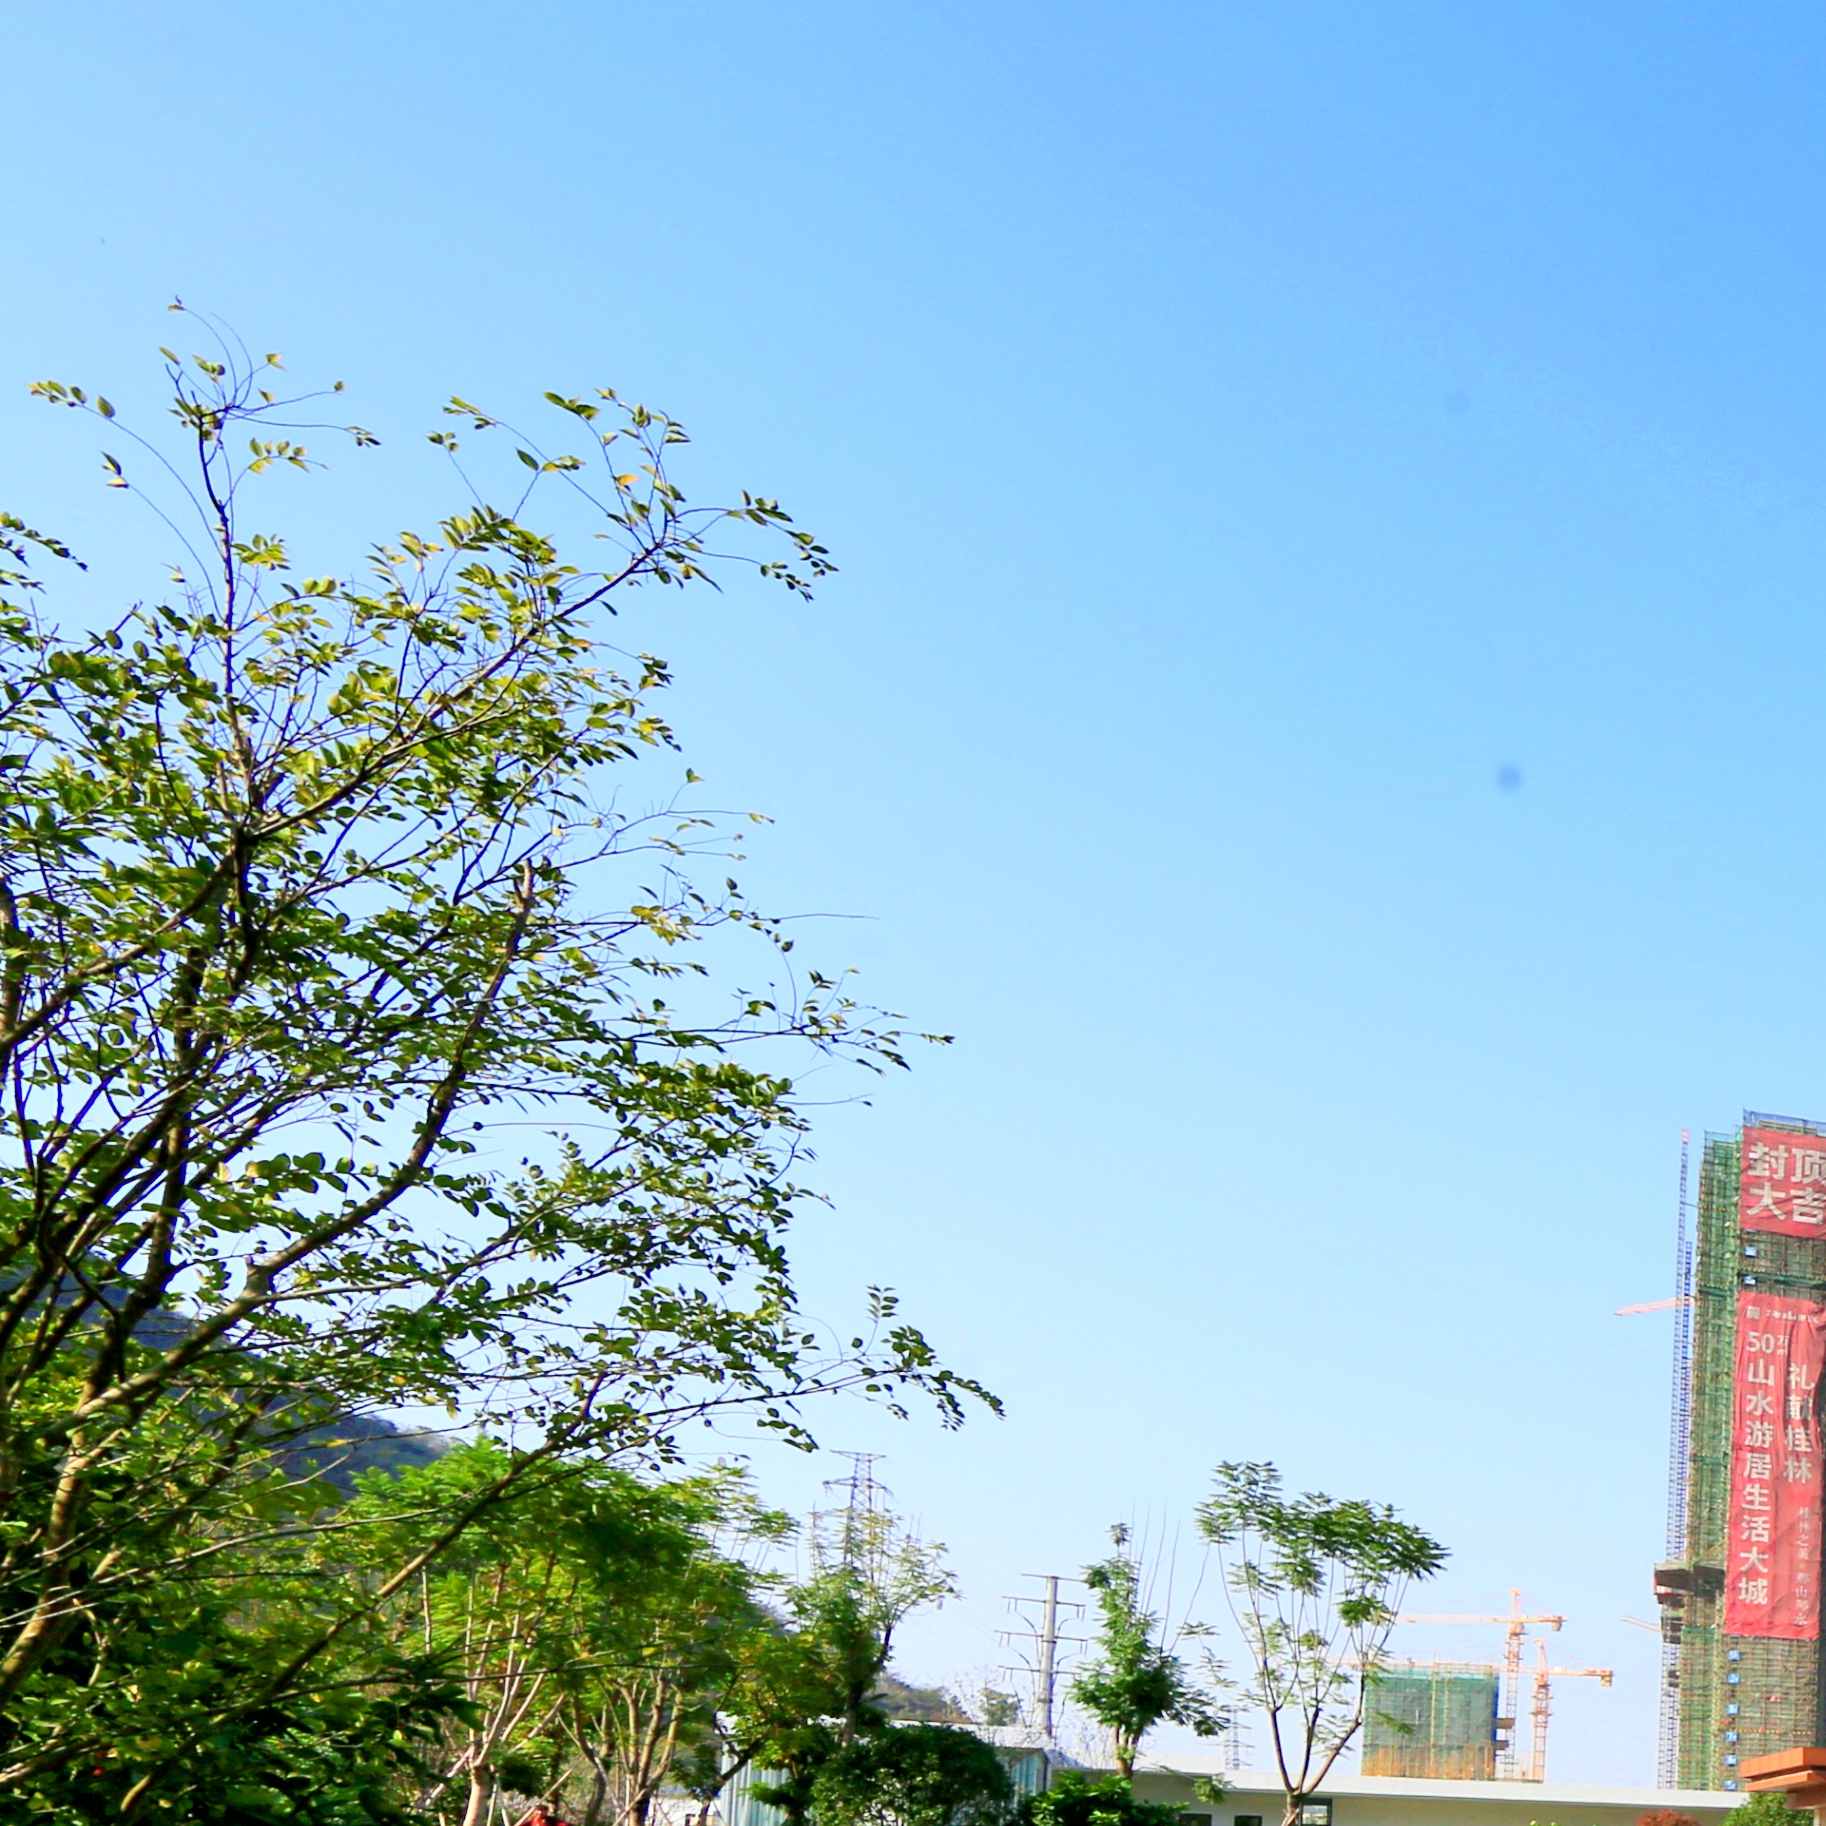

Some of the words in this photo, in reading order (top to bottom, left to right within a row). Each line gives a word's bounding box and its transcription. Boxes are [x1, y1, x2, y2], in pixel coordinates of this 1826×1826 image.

[1738, 1358, 1775, 1606] 山水游居生活大城
